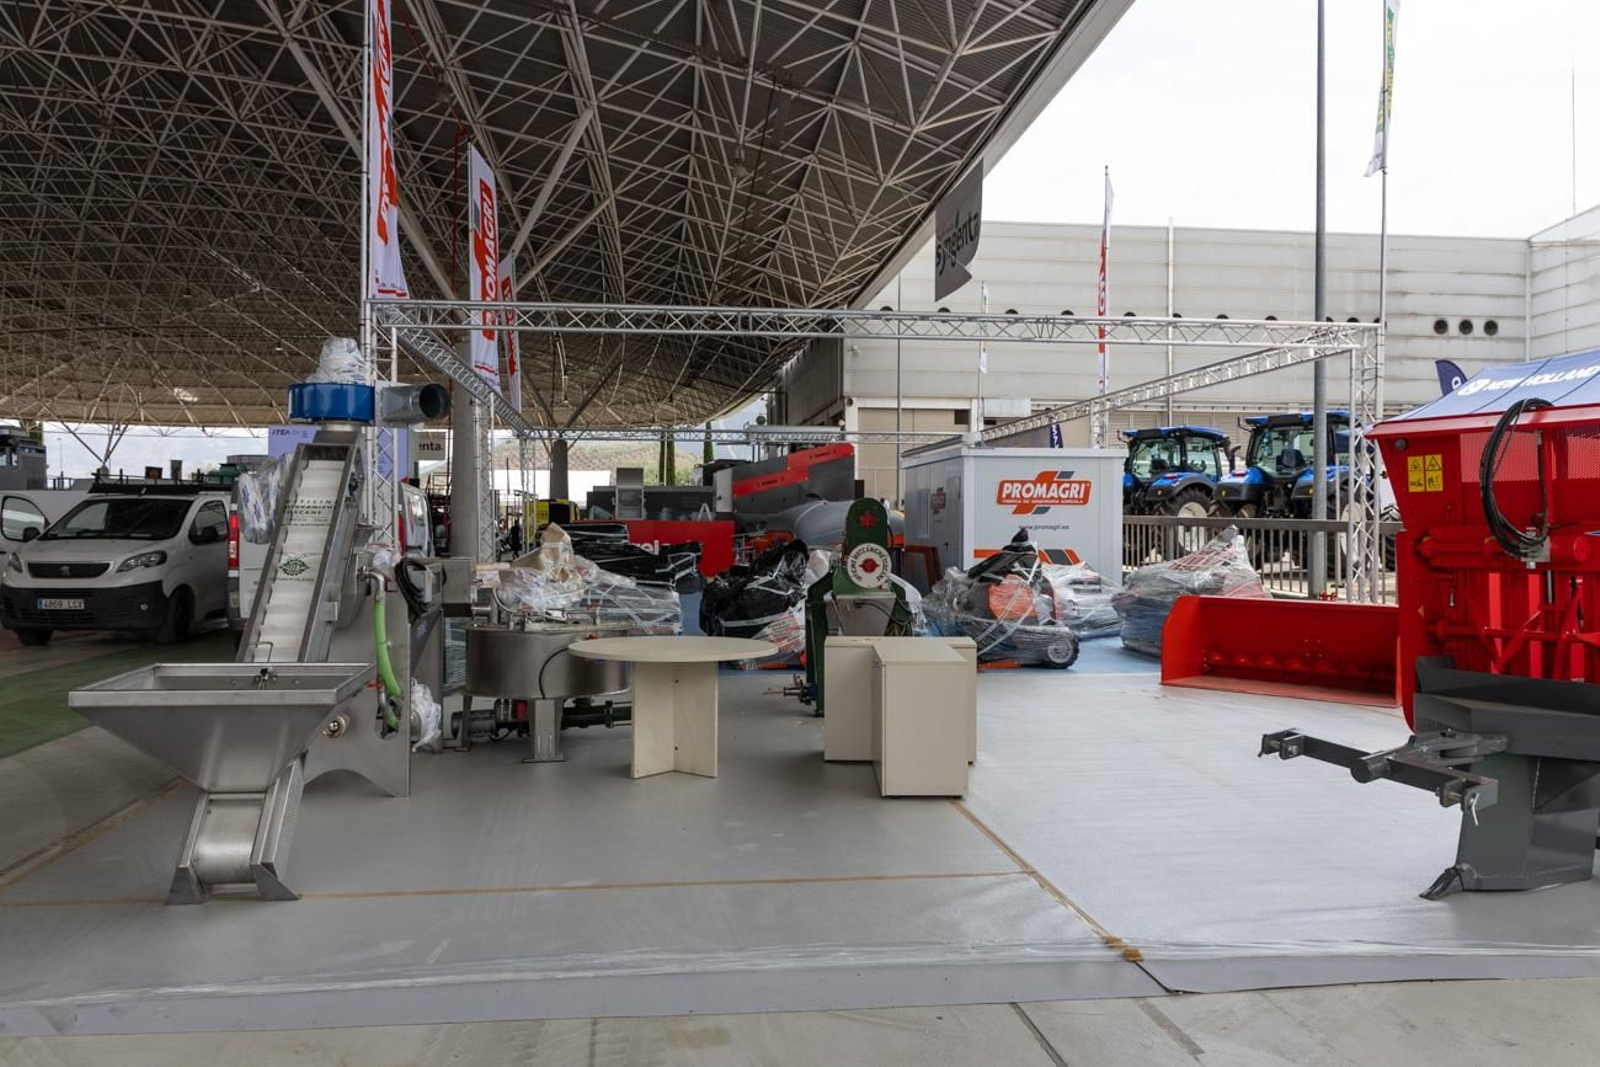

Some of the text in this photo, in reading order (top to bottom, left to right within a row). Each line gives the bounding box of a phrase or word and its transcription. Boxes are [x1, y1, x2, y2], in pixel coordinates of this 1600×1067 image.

[936, 208, 979, 276] syngenta
[1521, 366, 1600, 385] HOLLAND
[1002, 482, 1085, 499] PROMAGRI
